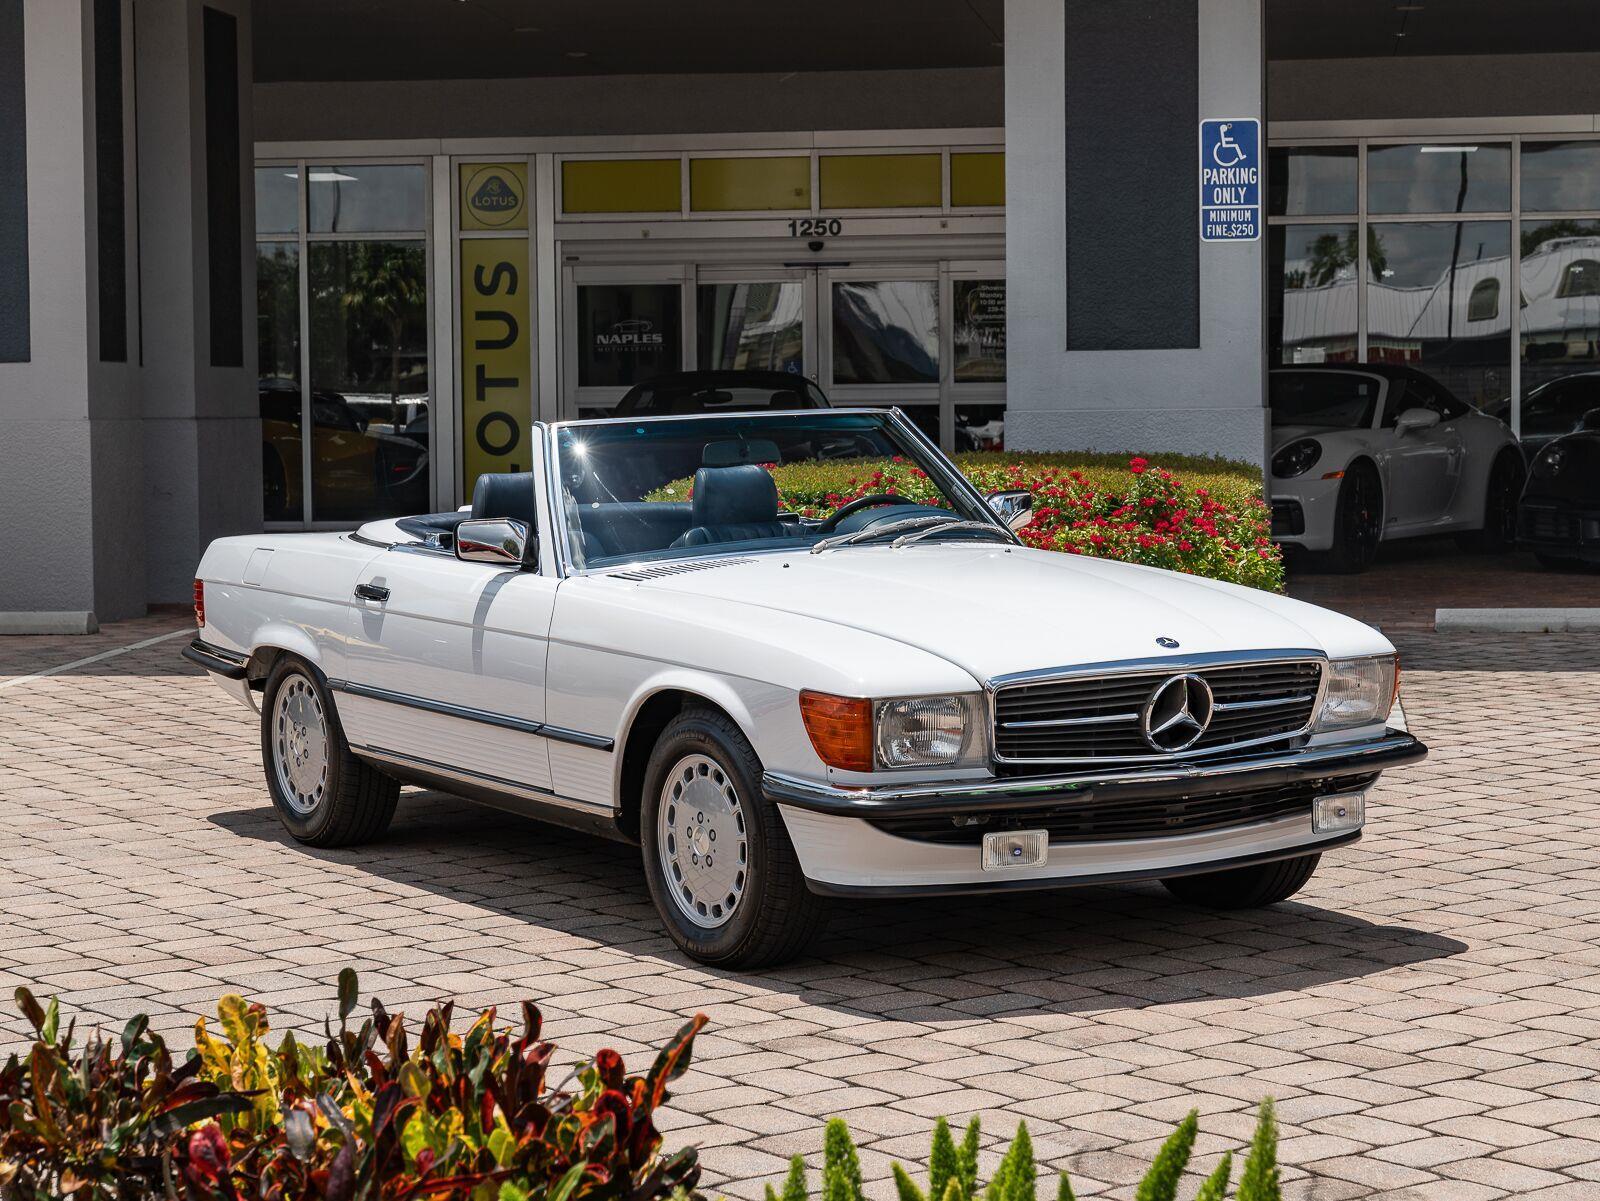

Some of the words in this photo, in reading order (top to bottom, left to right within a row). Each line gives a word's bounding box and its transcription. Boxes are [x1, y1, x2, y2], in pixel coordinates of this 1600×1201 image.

[1203, 167, 1257, 185] PARKING
[475, 195, 516, 206] LOTUS
[1213, 187, 1247, 204] ONLY
[1209, 210, 1252, 222] MINIMUM
[788, 218, 842, 237] 1250
[1207, 224, 1228, 236] FINE
[1231, 223, 1254, 237] $250
[596, 333, 663, 344] NAPLES
[474, 261, 520, 473] OTUS
